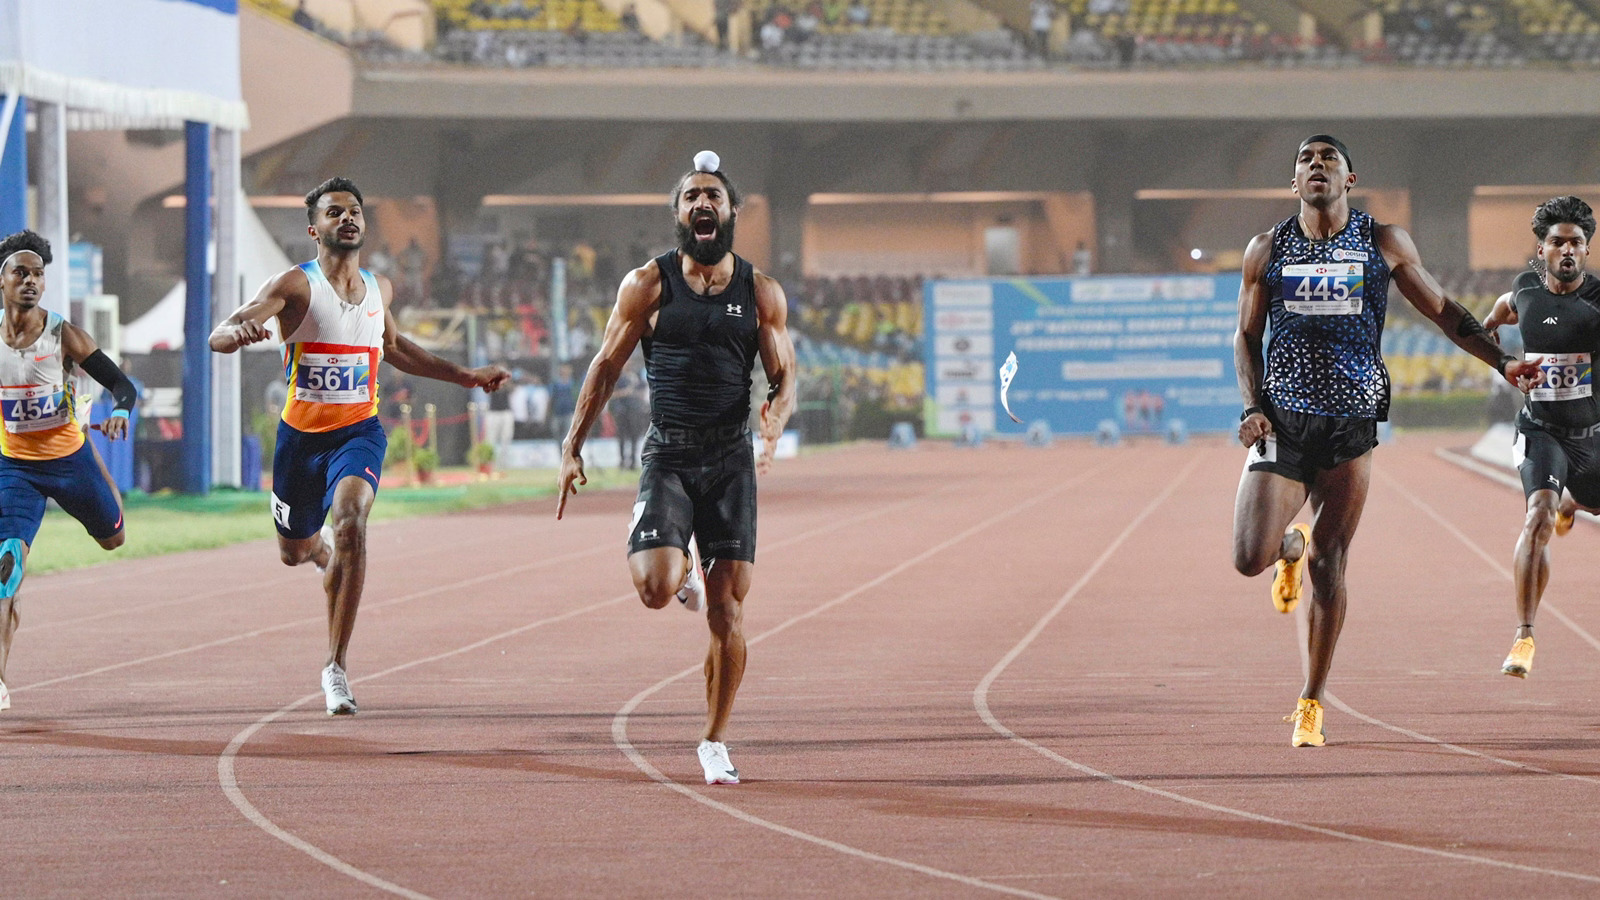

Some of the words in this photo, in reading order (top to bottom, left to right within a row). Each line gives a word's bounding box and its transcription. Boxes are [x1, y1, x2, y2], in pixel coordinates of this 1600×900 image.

[1344, 250, 1367, 258] ODISHA
[1294, 276, 1349, 302] 445
[307, 366, 355, 391] 561
[1536, 366, 1579, 389] 68
[11, 395, 58, 421] 454
[275, 502, 283, 521] 5
